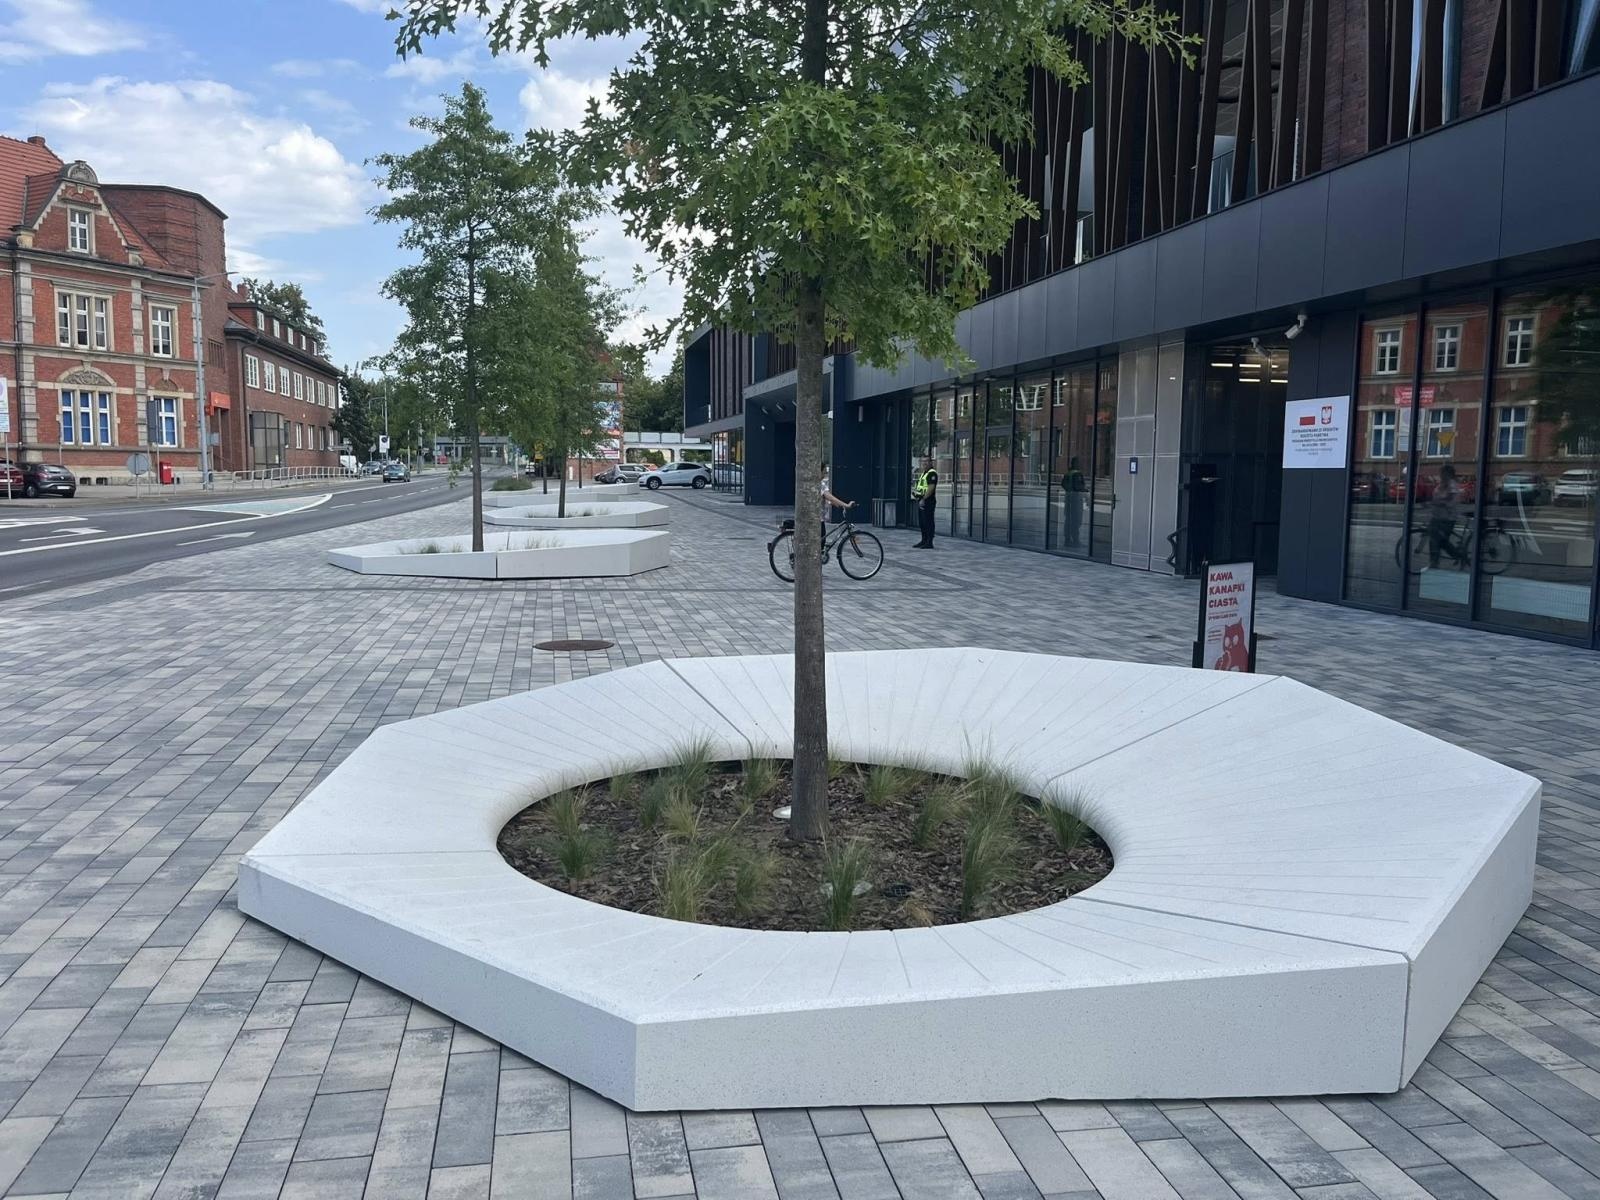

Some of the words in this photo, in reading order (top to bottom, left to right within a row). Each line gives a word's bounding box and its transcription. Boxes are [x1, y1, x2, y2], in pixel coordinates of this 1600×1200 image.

[1210, 571, 1233, 582] KAWA
[1209, 583, 1245, 596] KANAPKI
[1208, 597, 1239, 609] CIASTA
